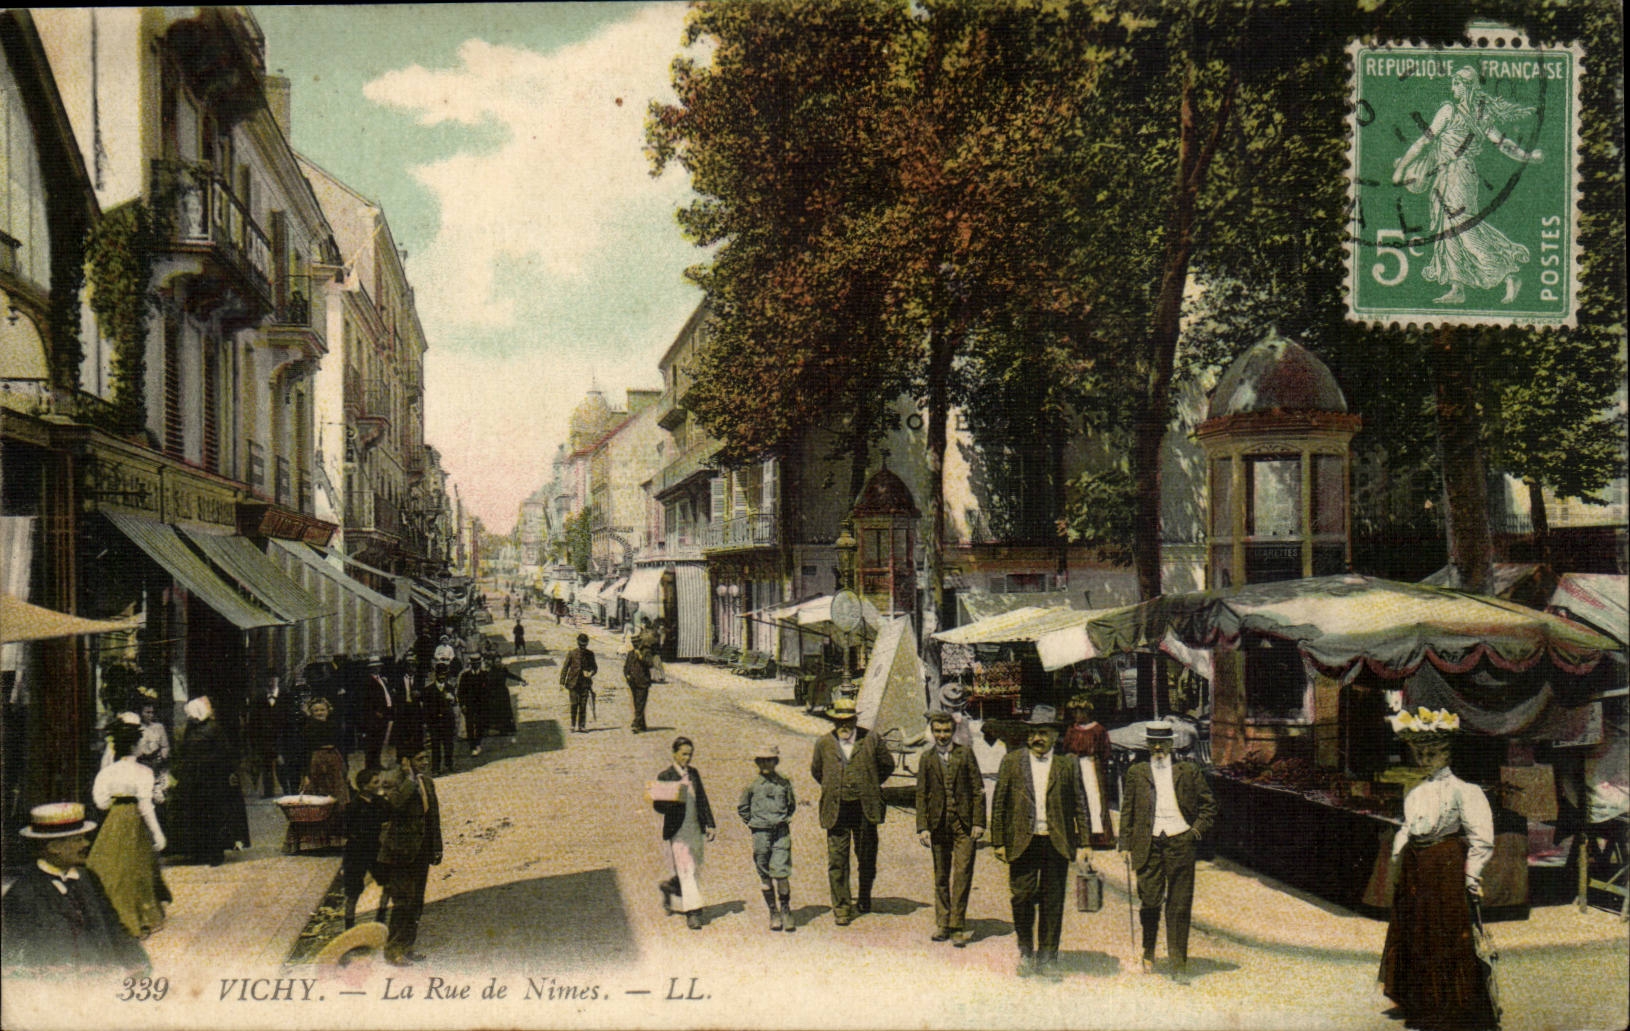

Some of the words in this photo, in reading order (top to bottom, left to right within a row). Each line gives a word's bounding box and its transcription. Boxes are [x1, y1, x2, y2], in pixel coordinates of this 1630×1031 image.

[1365, 58, 1455, 80] REPUBLIQUE
[1481, 59, 1564, 80] FRANÇAISE
[1540, 215, 1561, 302] POSTES
